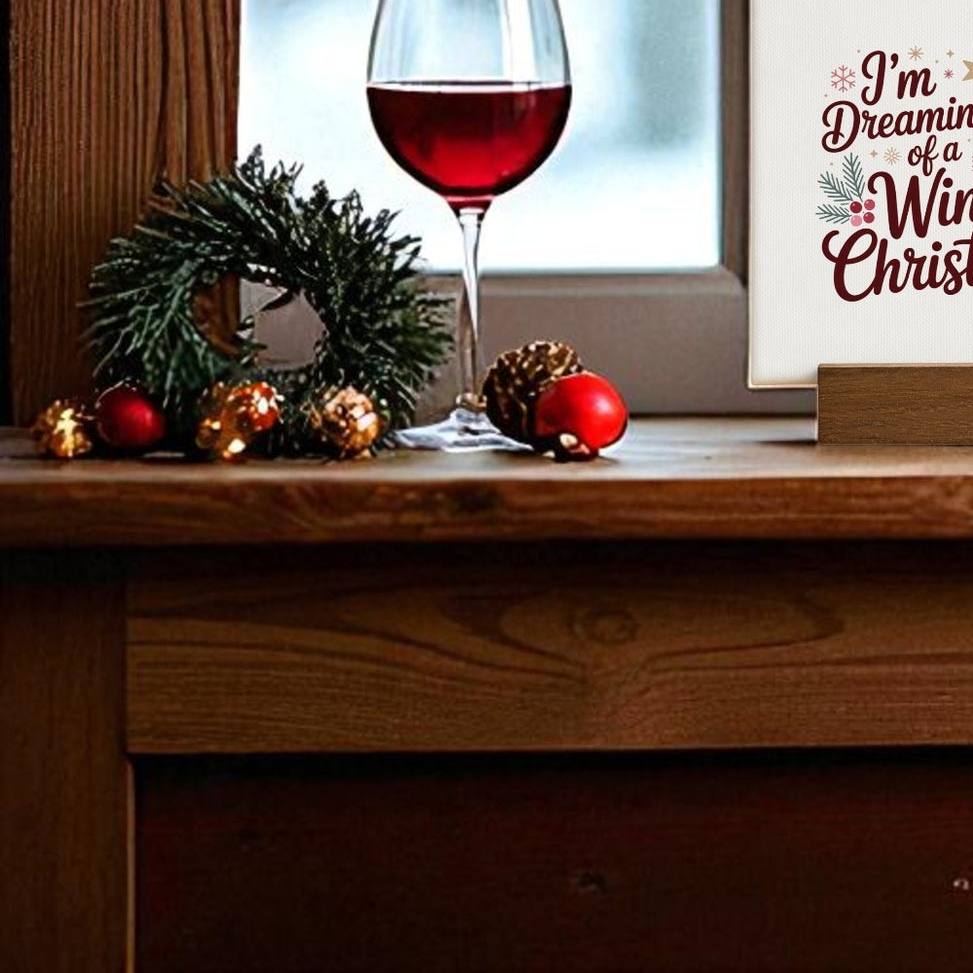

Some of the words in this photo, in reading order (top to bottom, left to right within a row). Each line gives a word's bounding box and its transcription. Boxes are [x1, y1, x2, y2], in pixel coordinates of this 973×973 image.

[861, 50, 937, 106] I'm
[907, 134, 939, 177] of
[943, 141, 963, 162] a
